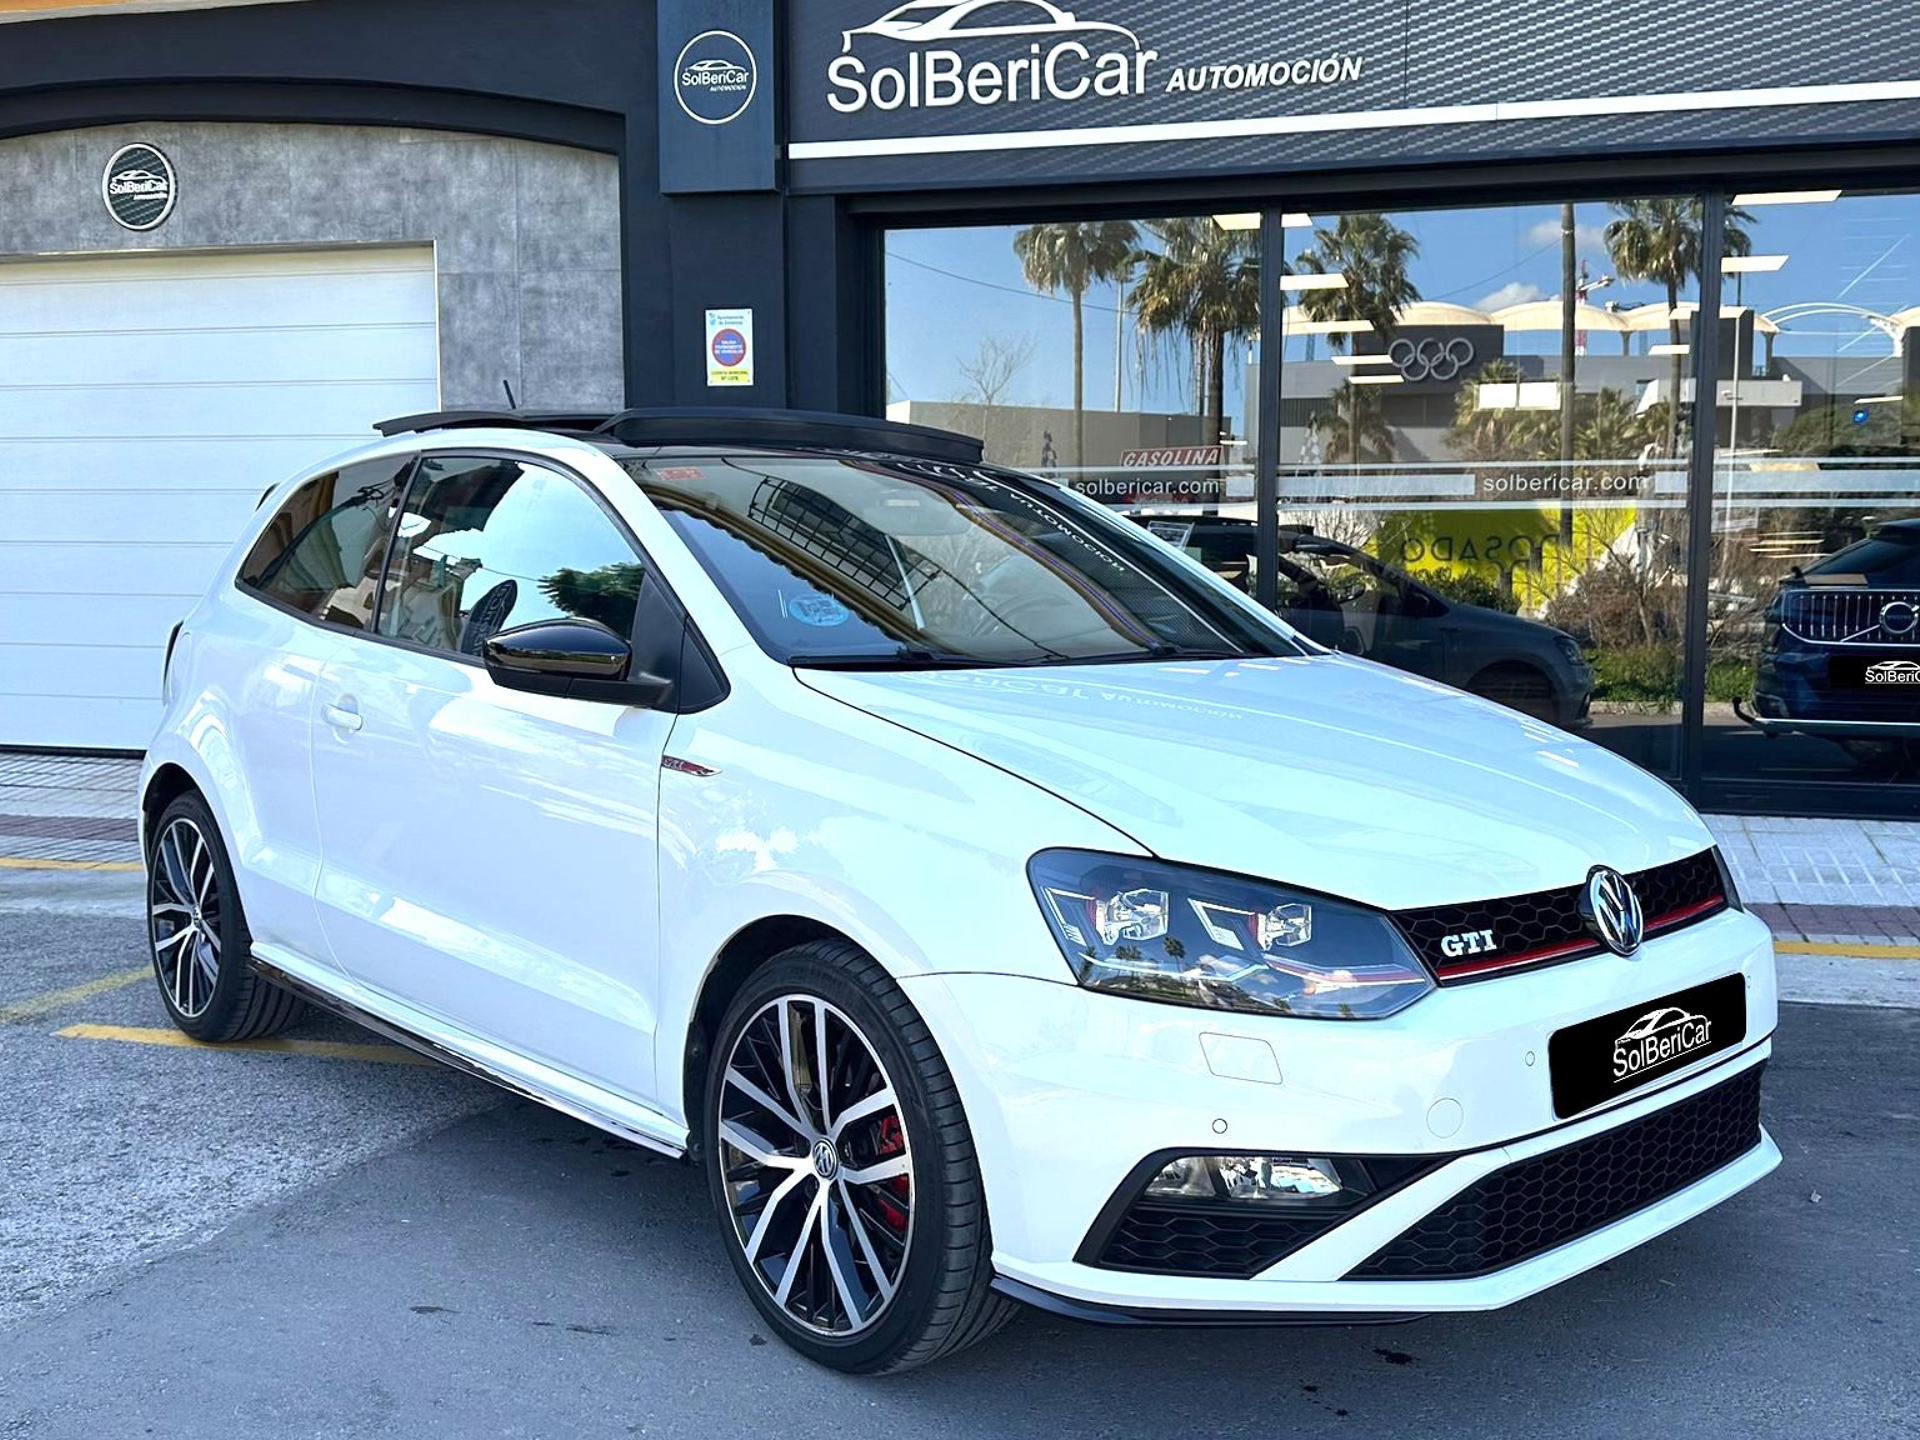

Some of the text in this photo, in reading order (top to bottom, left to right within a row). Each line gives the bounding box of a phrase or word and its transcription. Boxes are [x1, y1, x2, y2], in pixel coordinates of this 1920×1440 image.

[682, 70, 749, 86] SolBeriCar
[827, 42, 1362, 112] SolBeriCar AUTOMOCIÓN
[1123, 449, 1219, 467] GASOLINA
[1076, 478, 1219, 496] solbericar.com
[1484, 473, 1648, 492] solbericar.com
[1440, 929, 1497, 958] GTI
